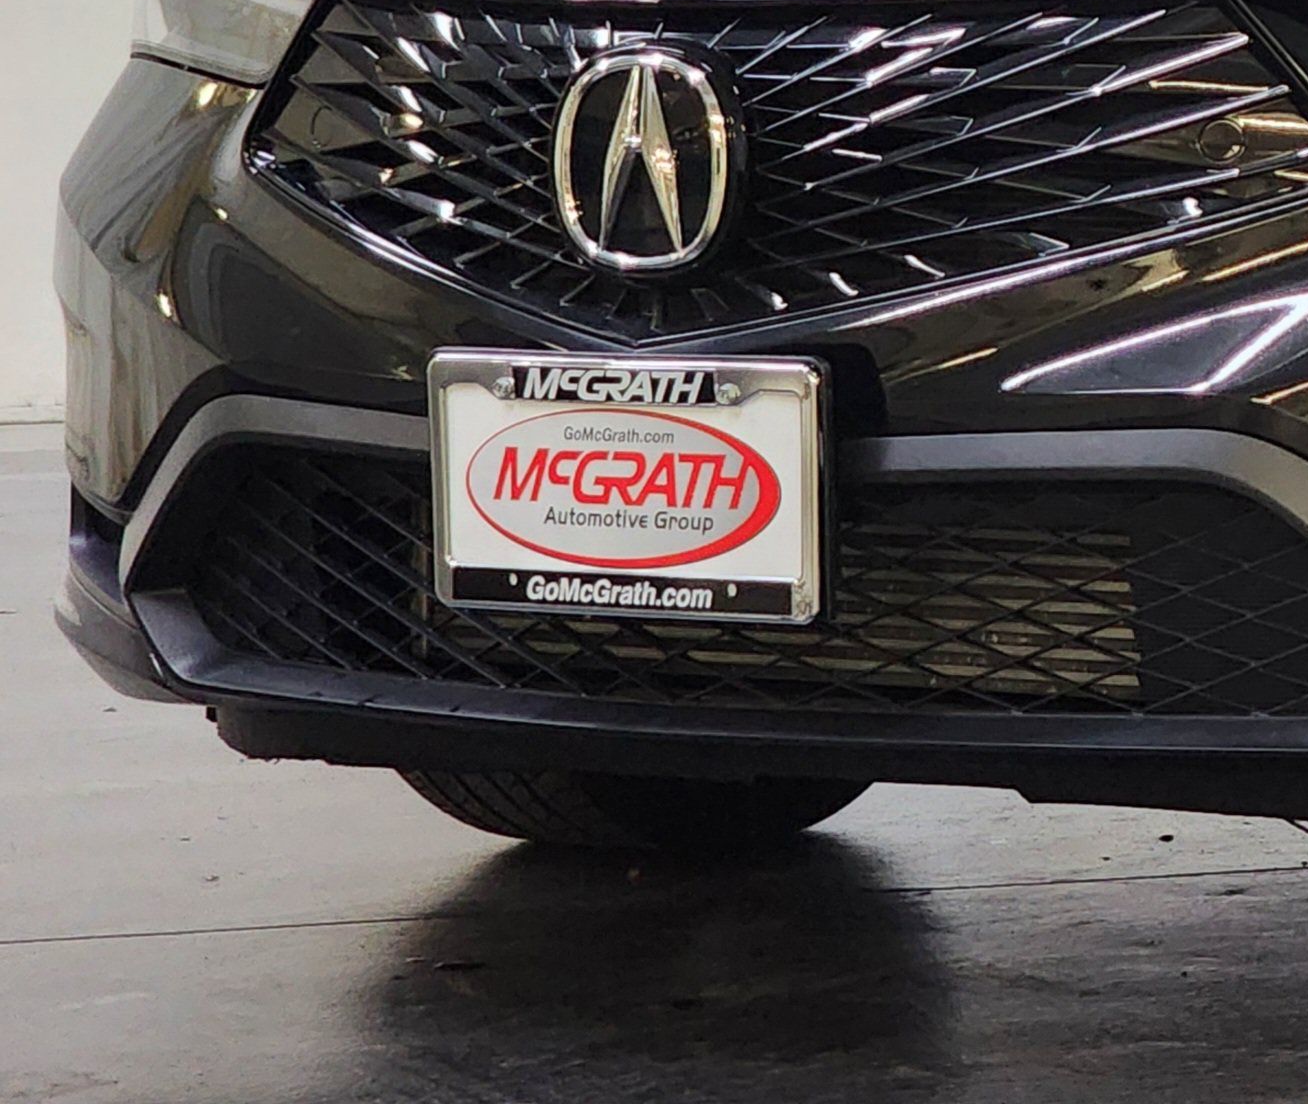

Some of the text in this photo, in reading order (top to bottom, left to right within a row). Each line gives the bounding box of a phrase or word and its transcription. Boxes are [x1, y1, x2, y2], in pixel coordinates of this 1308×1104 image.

[524, 368, 703, 403] McGRATH
[563, 425, 675, 444] GoMcGrath.com
[493, 446, 751, 510] McGRATH
[544, 506, 714, 535] Automotive Group
[526, 574, 713, 608] GoMcGrath.com
